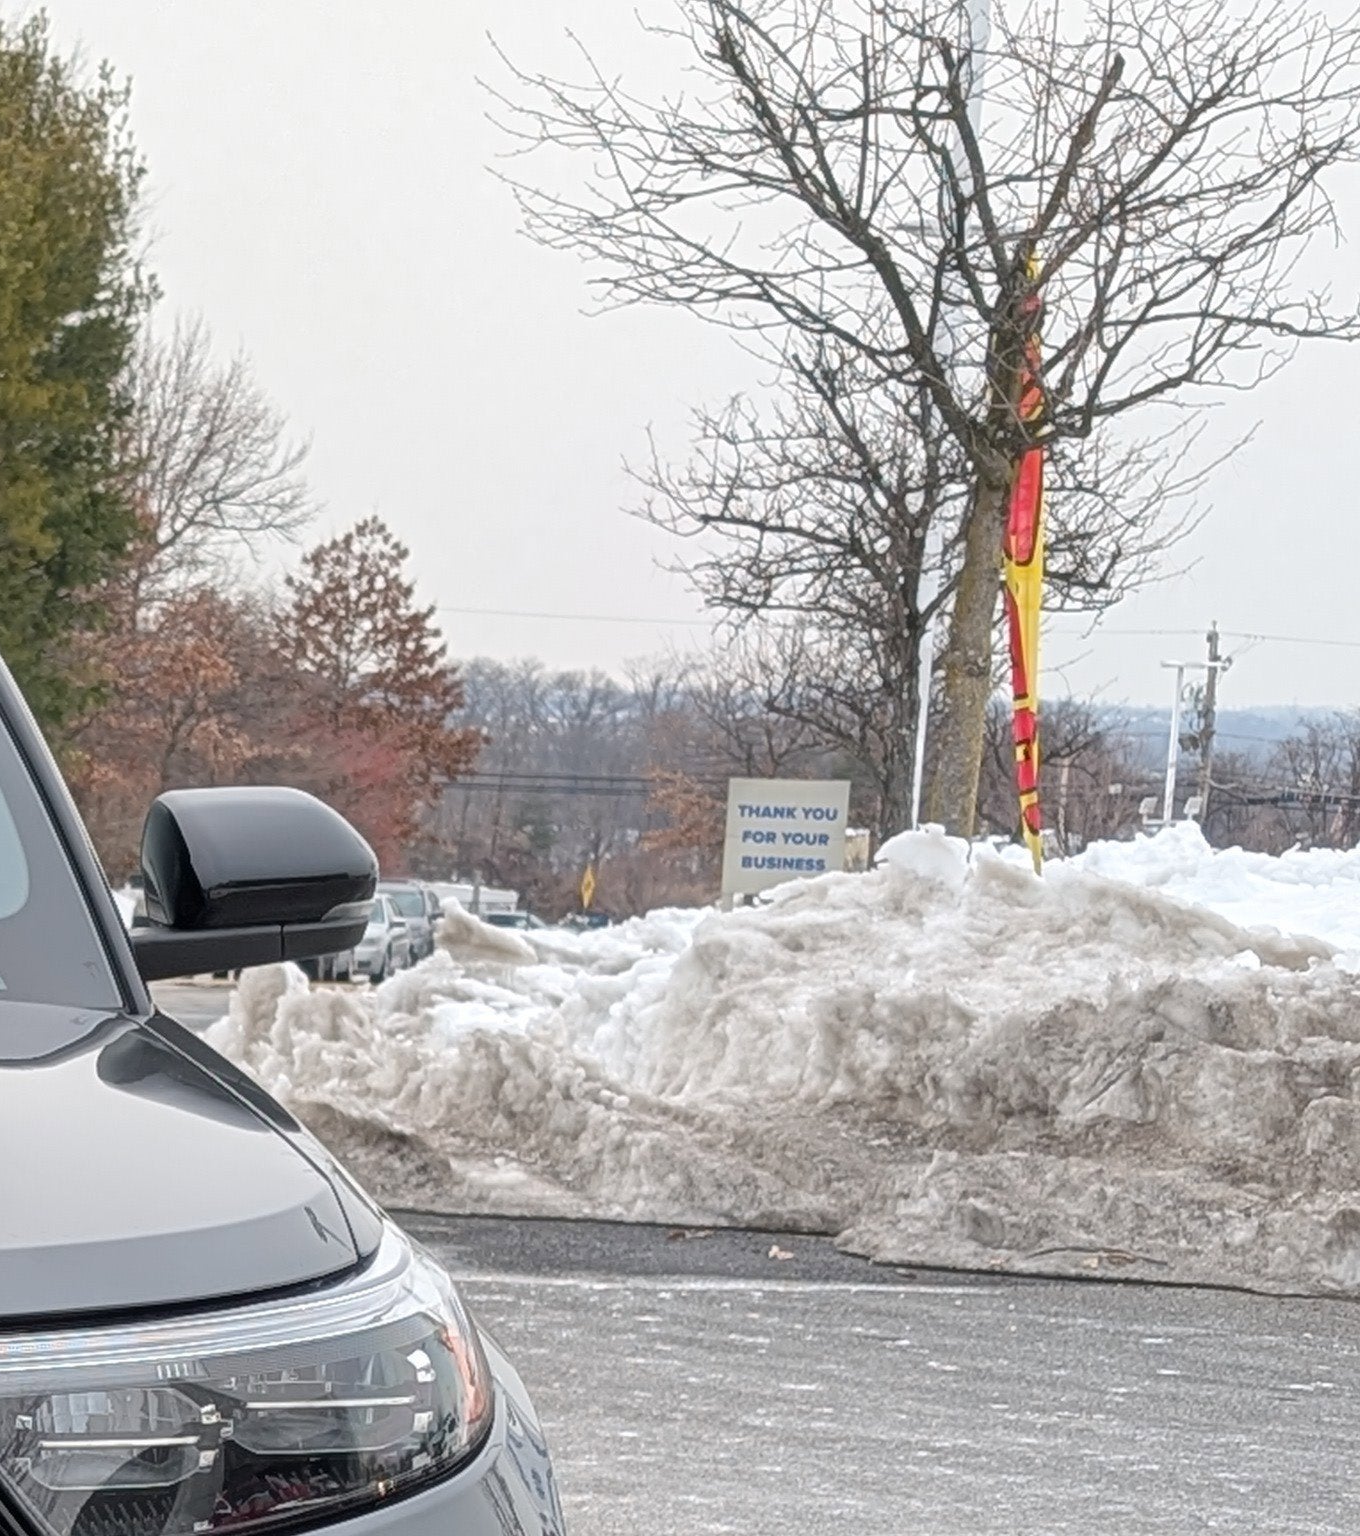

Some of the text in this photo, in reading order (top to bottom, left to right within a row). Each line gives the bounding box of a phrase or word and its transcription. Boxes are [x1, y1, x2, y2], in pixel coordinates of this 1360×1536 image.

[738, 805, 838, 821] THANK YOU
[742, 830, 830, 846] FOR YOUR
[741, 856, 826, 871] BUSINESS
